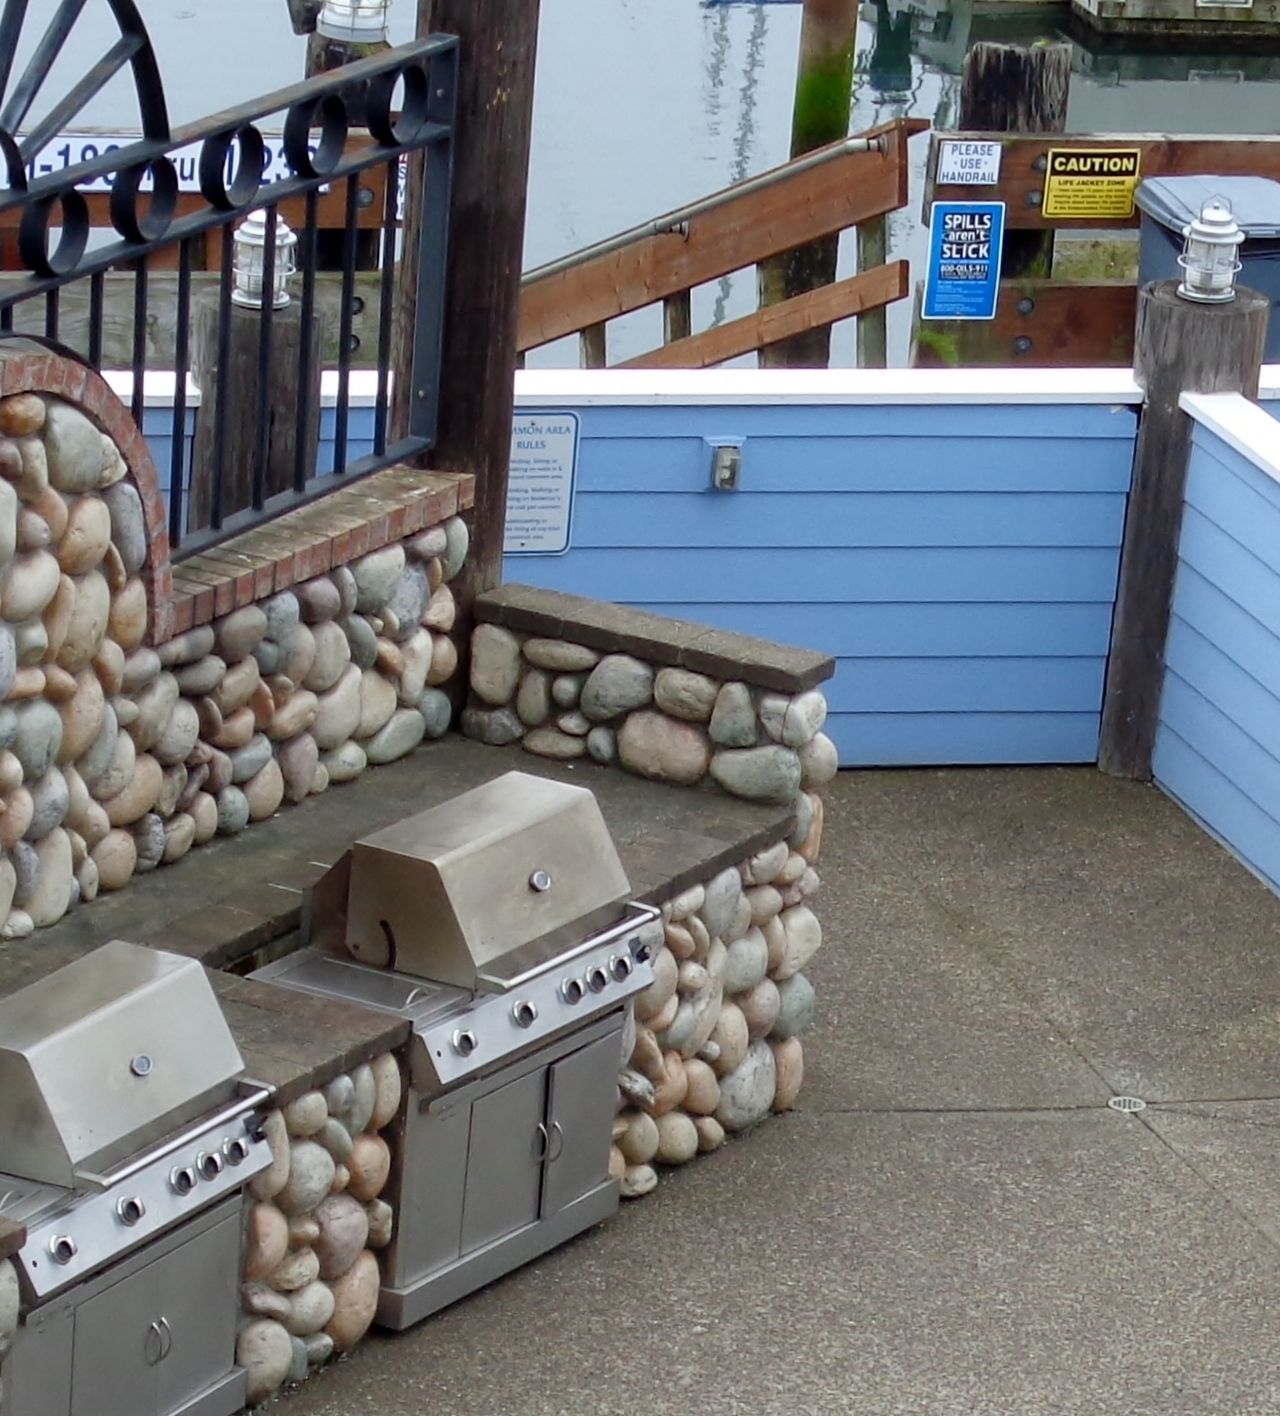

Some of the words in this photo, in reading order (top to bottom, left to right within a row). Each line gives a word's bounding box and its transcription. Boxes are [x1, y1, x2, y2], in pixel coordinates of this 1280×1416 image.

[951, 144, 993, 156] PLEASE
[960, 158, 983, 169] USE
[1054, 157, 1135, 172] CAUTION
[941, 171, 996, 182] HANDRAIL
[944, 214, 992, 229] SPILLS
[948, 230, 986, 241] aren't
[942, 243, 989, 258] SLICK
[516, 440, 547, 449] RULES
